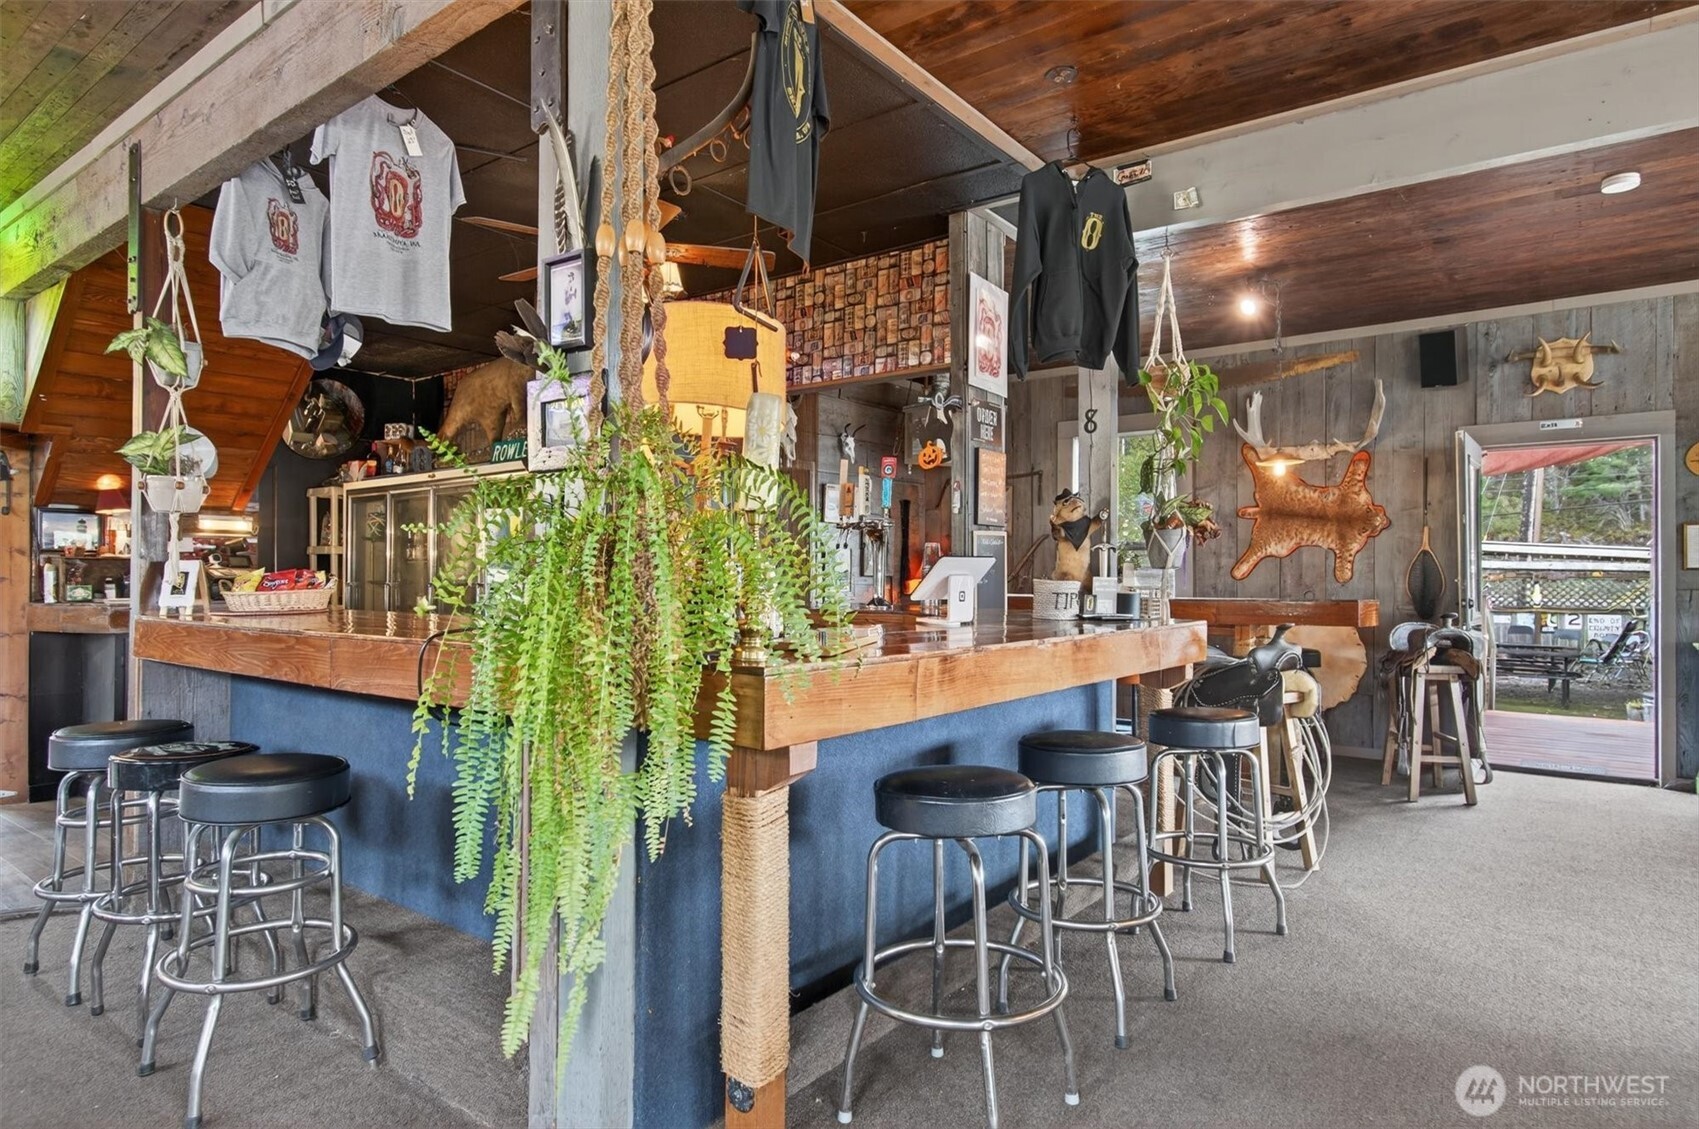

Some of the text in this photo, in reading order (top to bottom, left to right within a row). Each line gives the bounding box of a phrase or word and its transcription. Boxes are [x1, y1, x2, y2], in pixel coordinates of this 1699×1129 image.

[977, 406, 998, 427] ORDER
[1083, 408, 1098, 434] 8
[980, 424, 994, 441] HERE
[1568, 613, 1581, 625] 2
